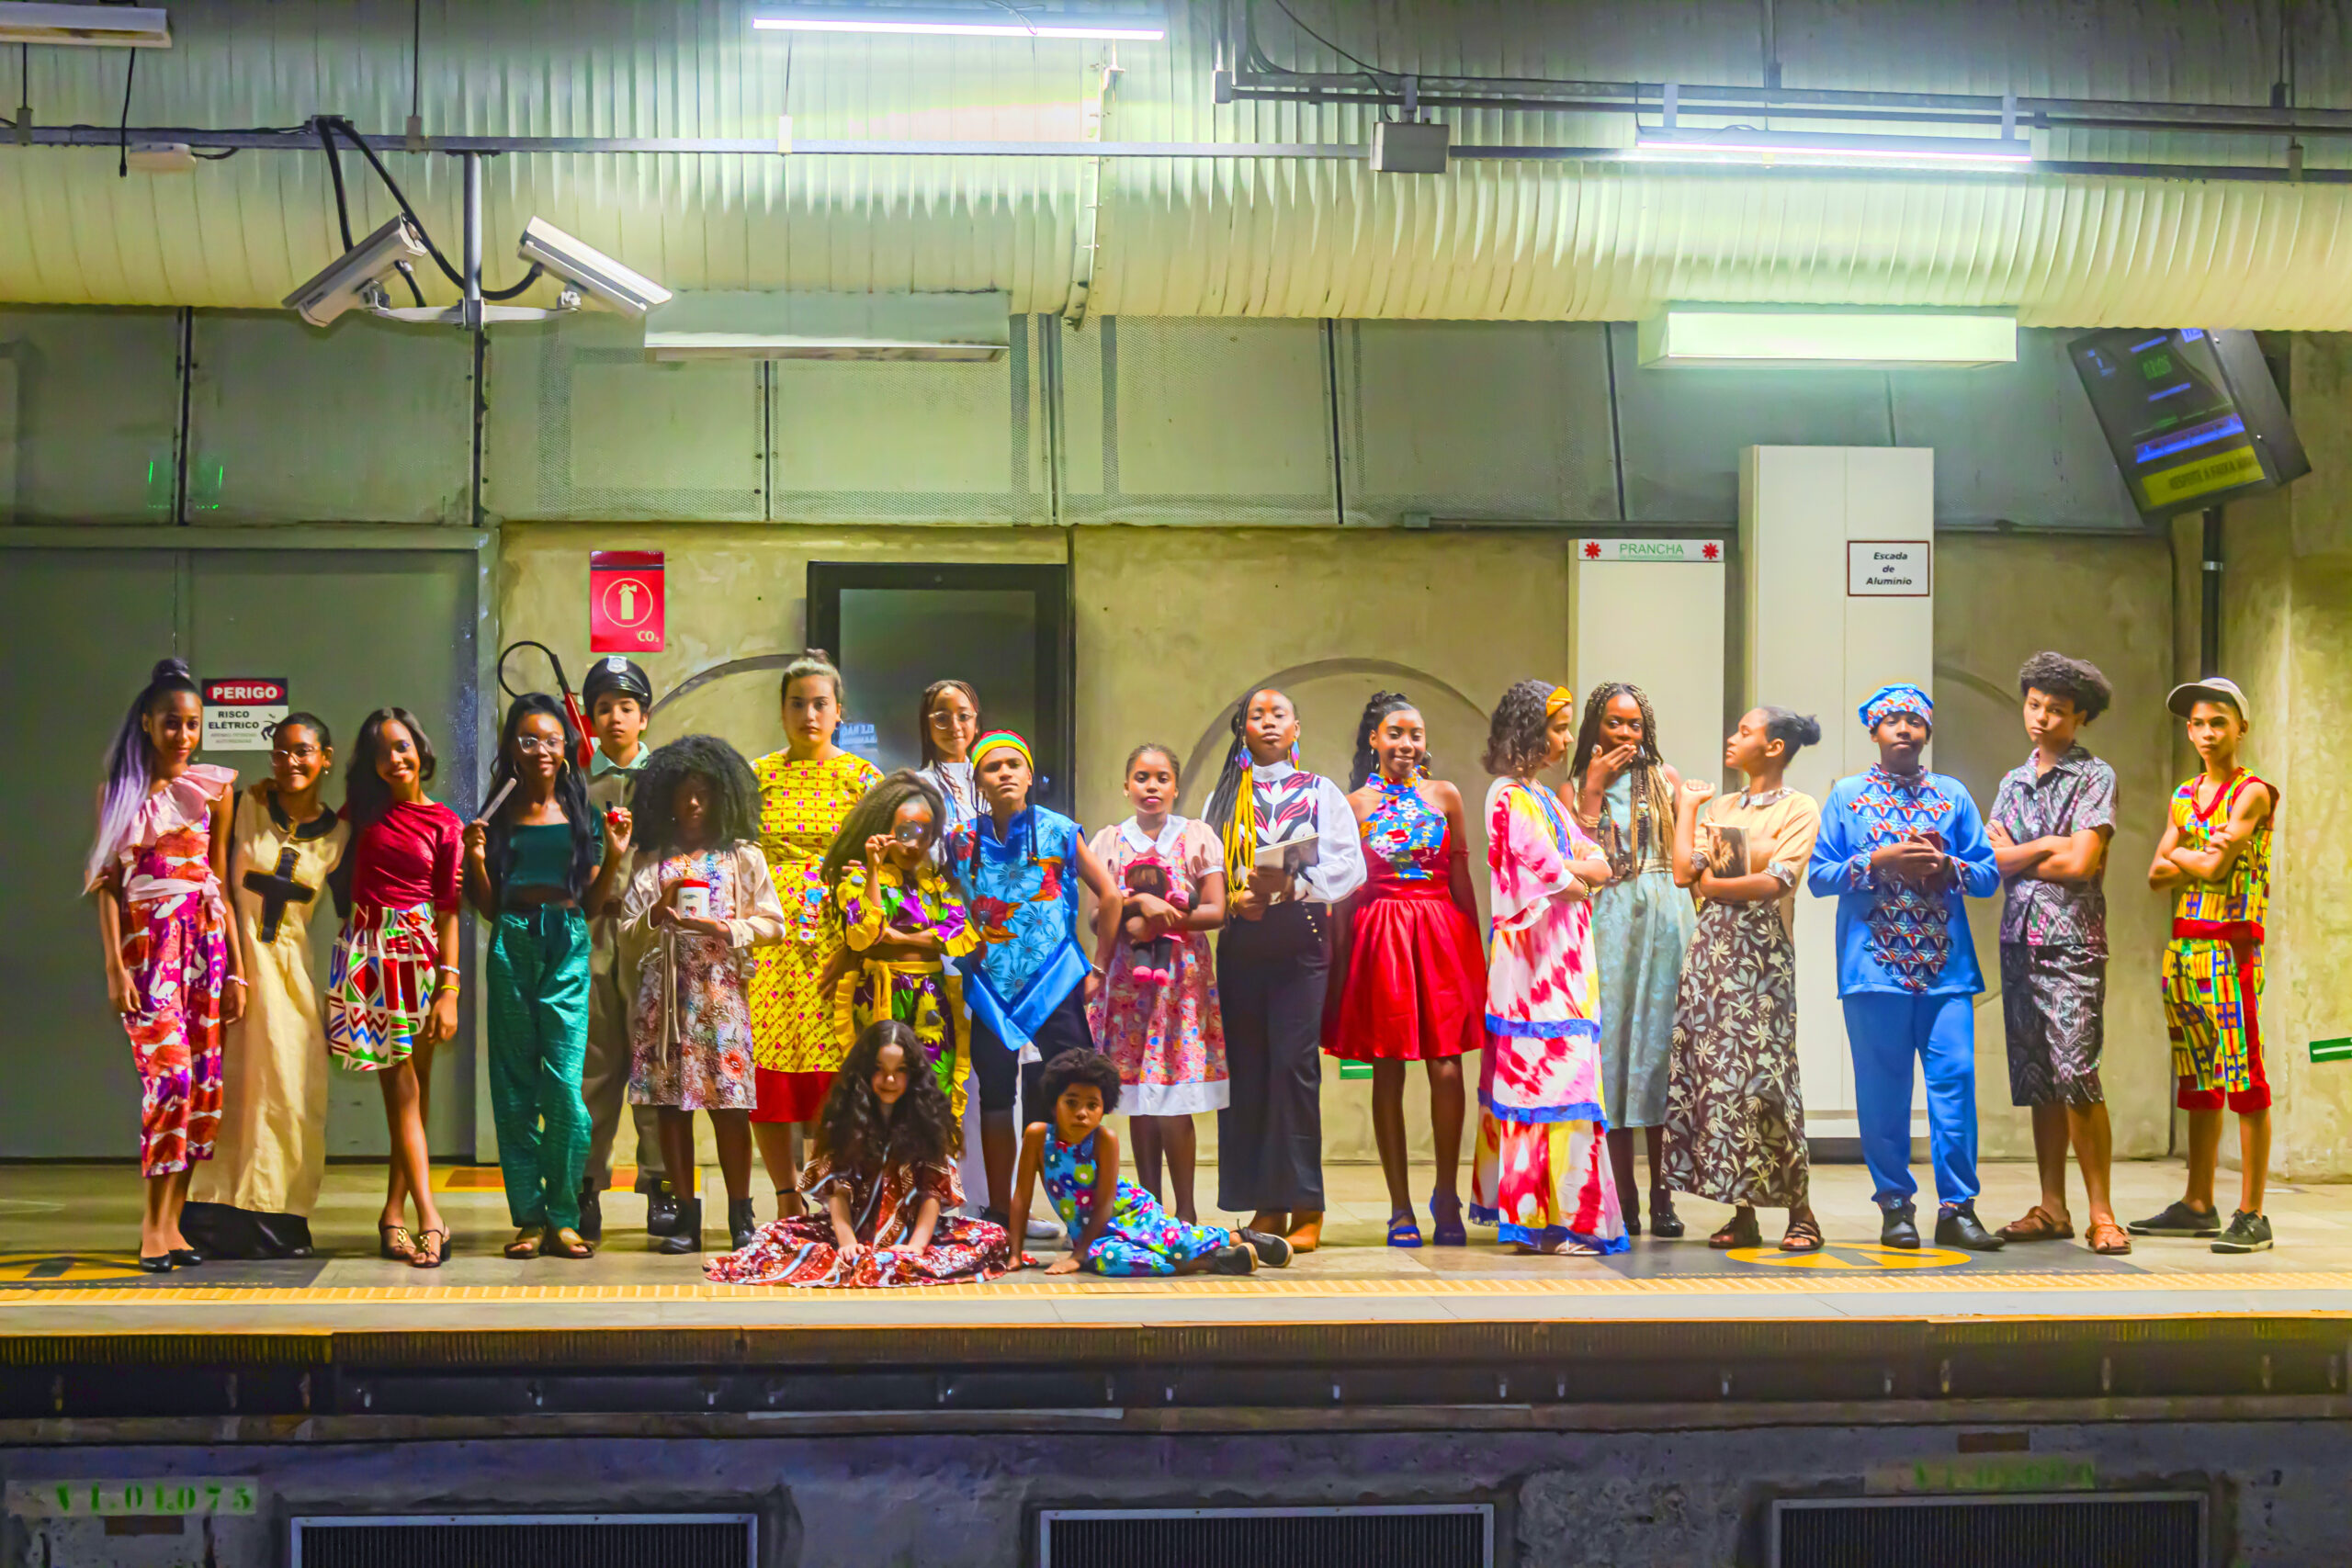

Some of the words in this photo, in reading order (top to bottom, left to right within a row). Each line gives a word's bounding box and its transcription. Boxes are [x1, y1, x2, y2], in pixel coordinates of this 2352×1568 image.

[1619, 543, 1684, 555] PRANCHA
[1873, 551, 1908, 560] Escada
[1882, 565, 1895, 573] de
[212, 686, 277, 699] PERIGO
[218, 710, 250, 718] RISCO
